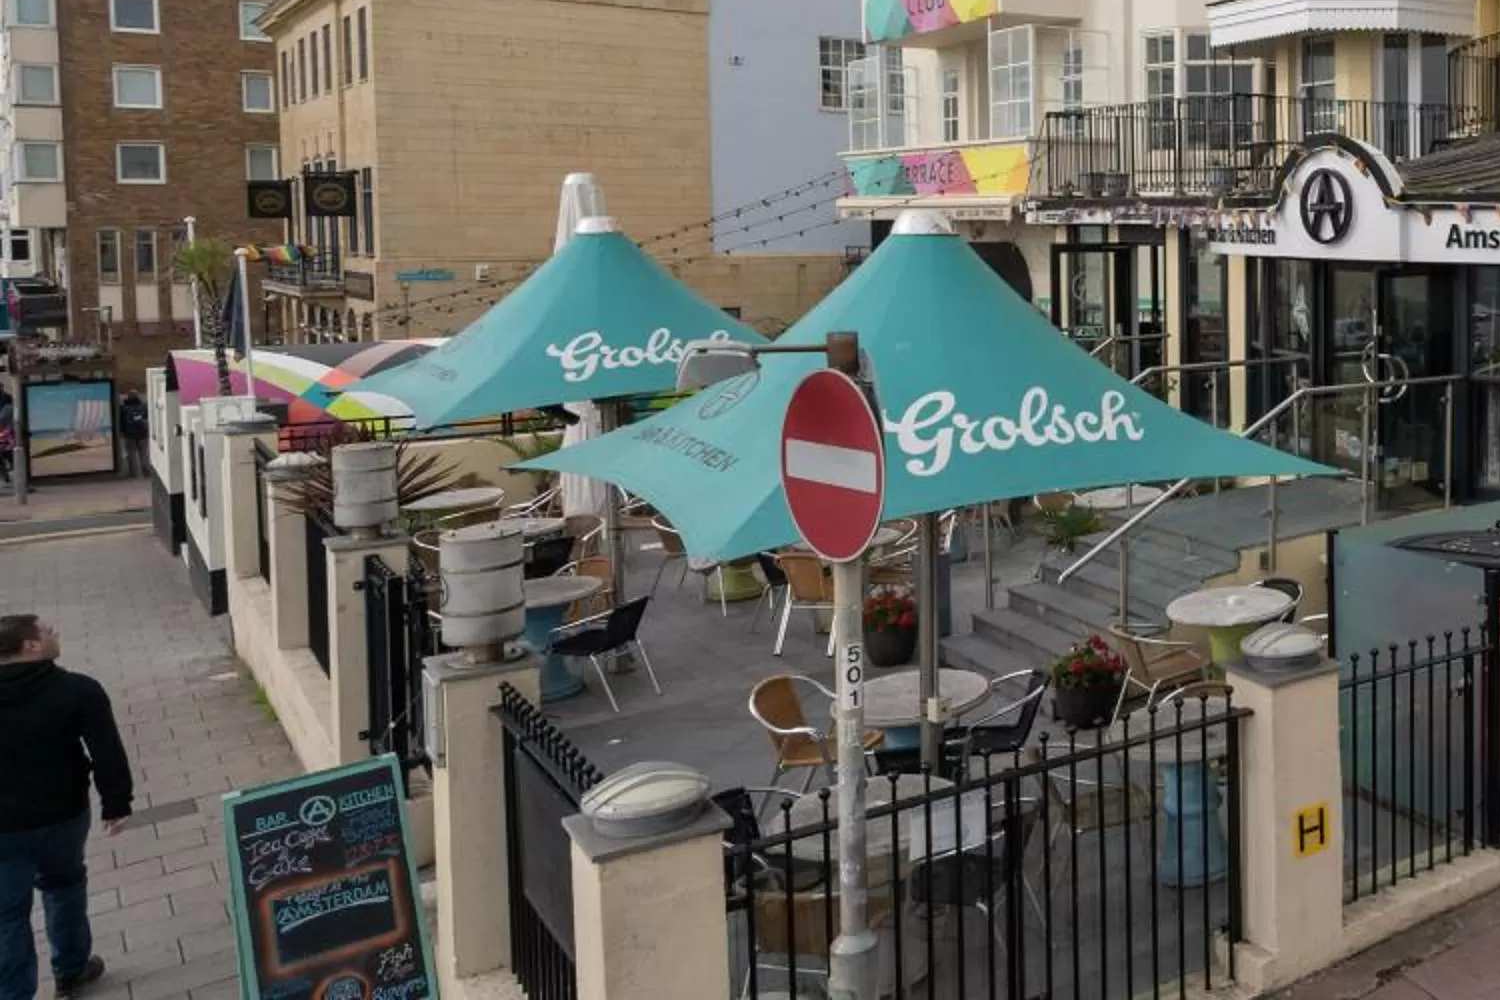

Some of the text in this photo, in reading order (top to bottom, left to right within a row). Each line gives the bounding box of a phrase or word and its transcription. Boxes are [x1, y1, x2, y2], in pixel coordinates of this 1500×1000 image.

[546, 327, 730, 382] Grols
[882, 386, 1144, 477] Grolsch
[847, 645, 861, 706] 501
[256, 811, 288, 831] BAR
[339, 783, 395, 810] KITCHEN
[1298, 807, 1325, 853] H
[277, 880, 389, 925] AMSTERDAM
